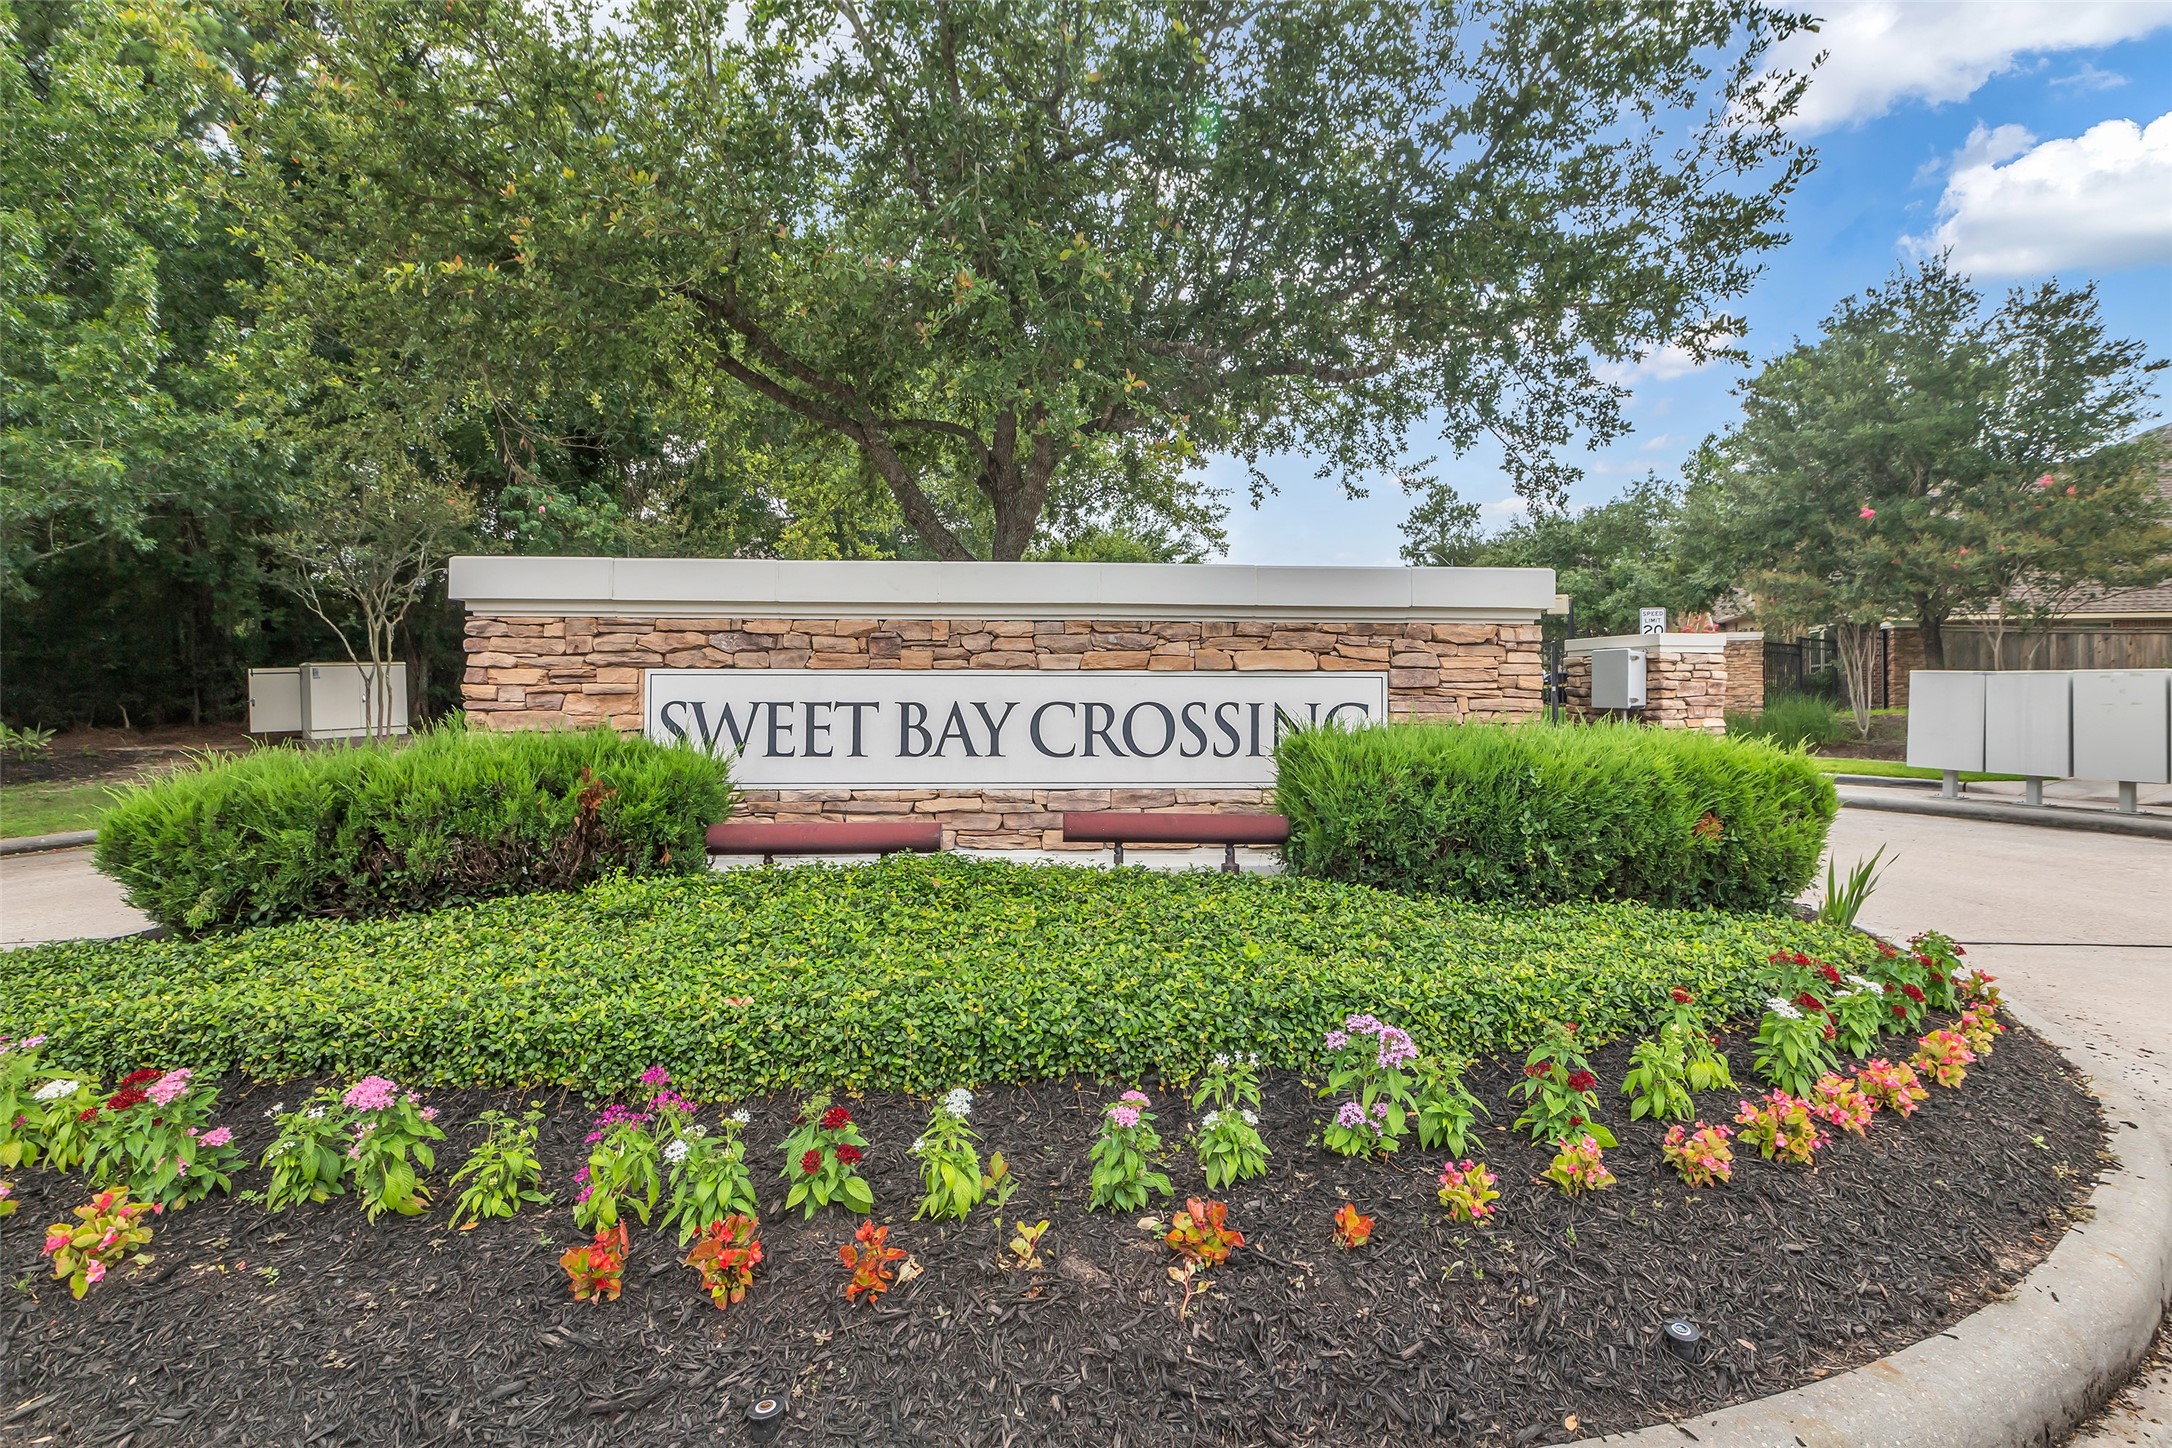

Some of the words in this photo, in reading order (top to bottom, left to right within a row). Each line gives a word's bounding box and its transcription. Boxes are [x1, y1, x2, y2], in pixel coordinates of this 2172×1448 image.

[1643, 625, 1664, 635] 20
[660, 700, 879, 758] SWEET
[895, 700, 1020, 757] BAY
